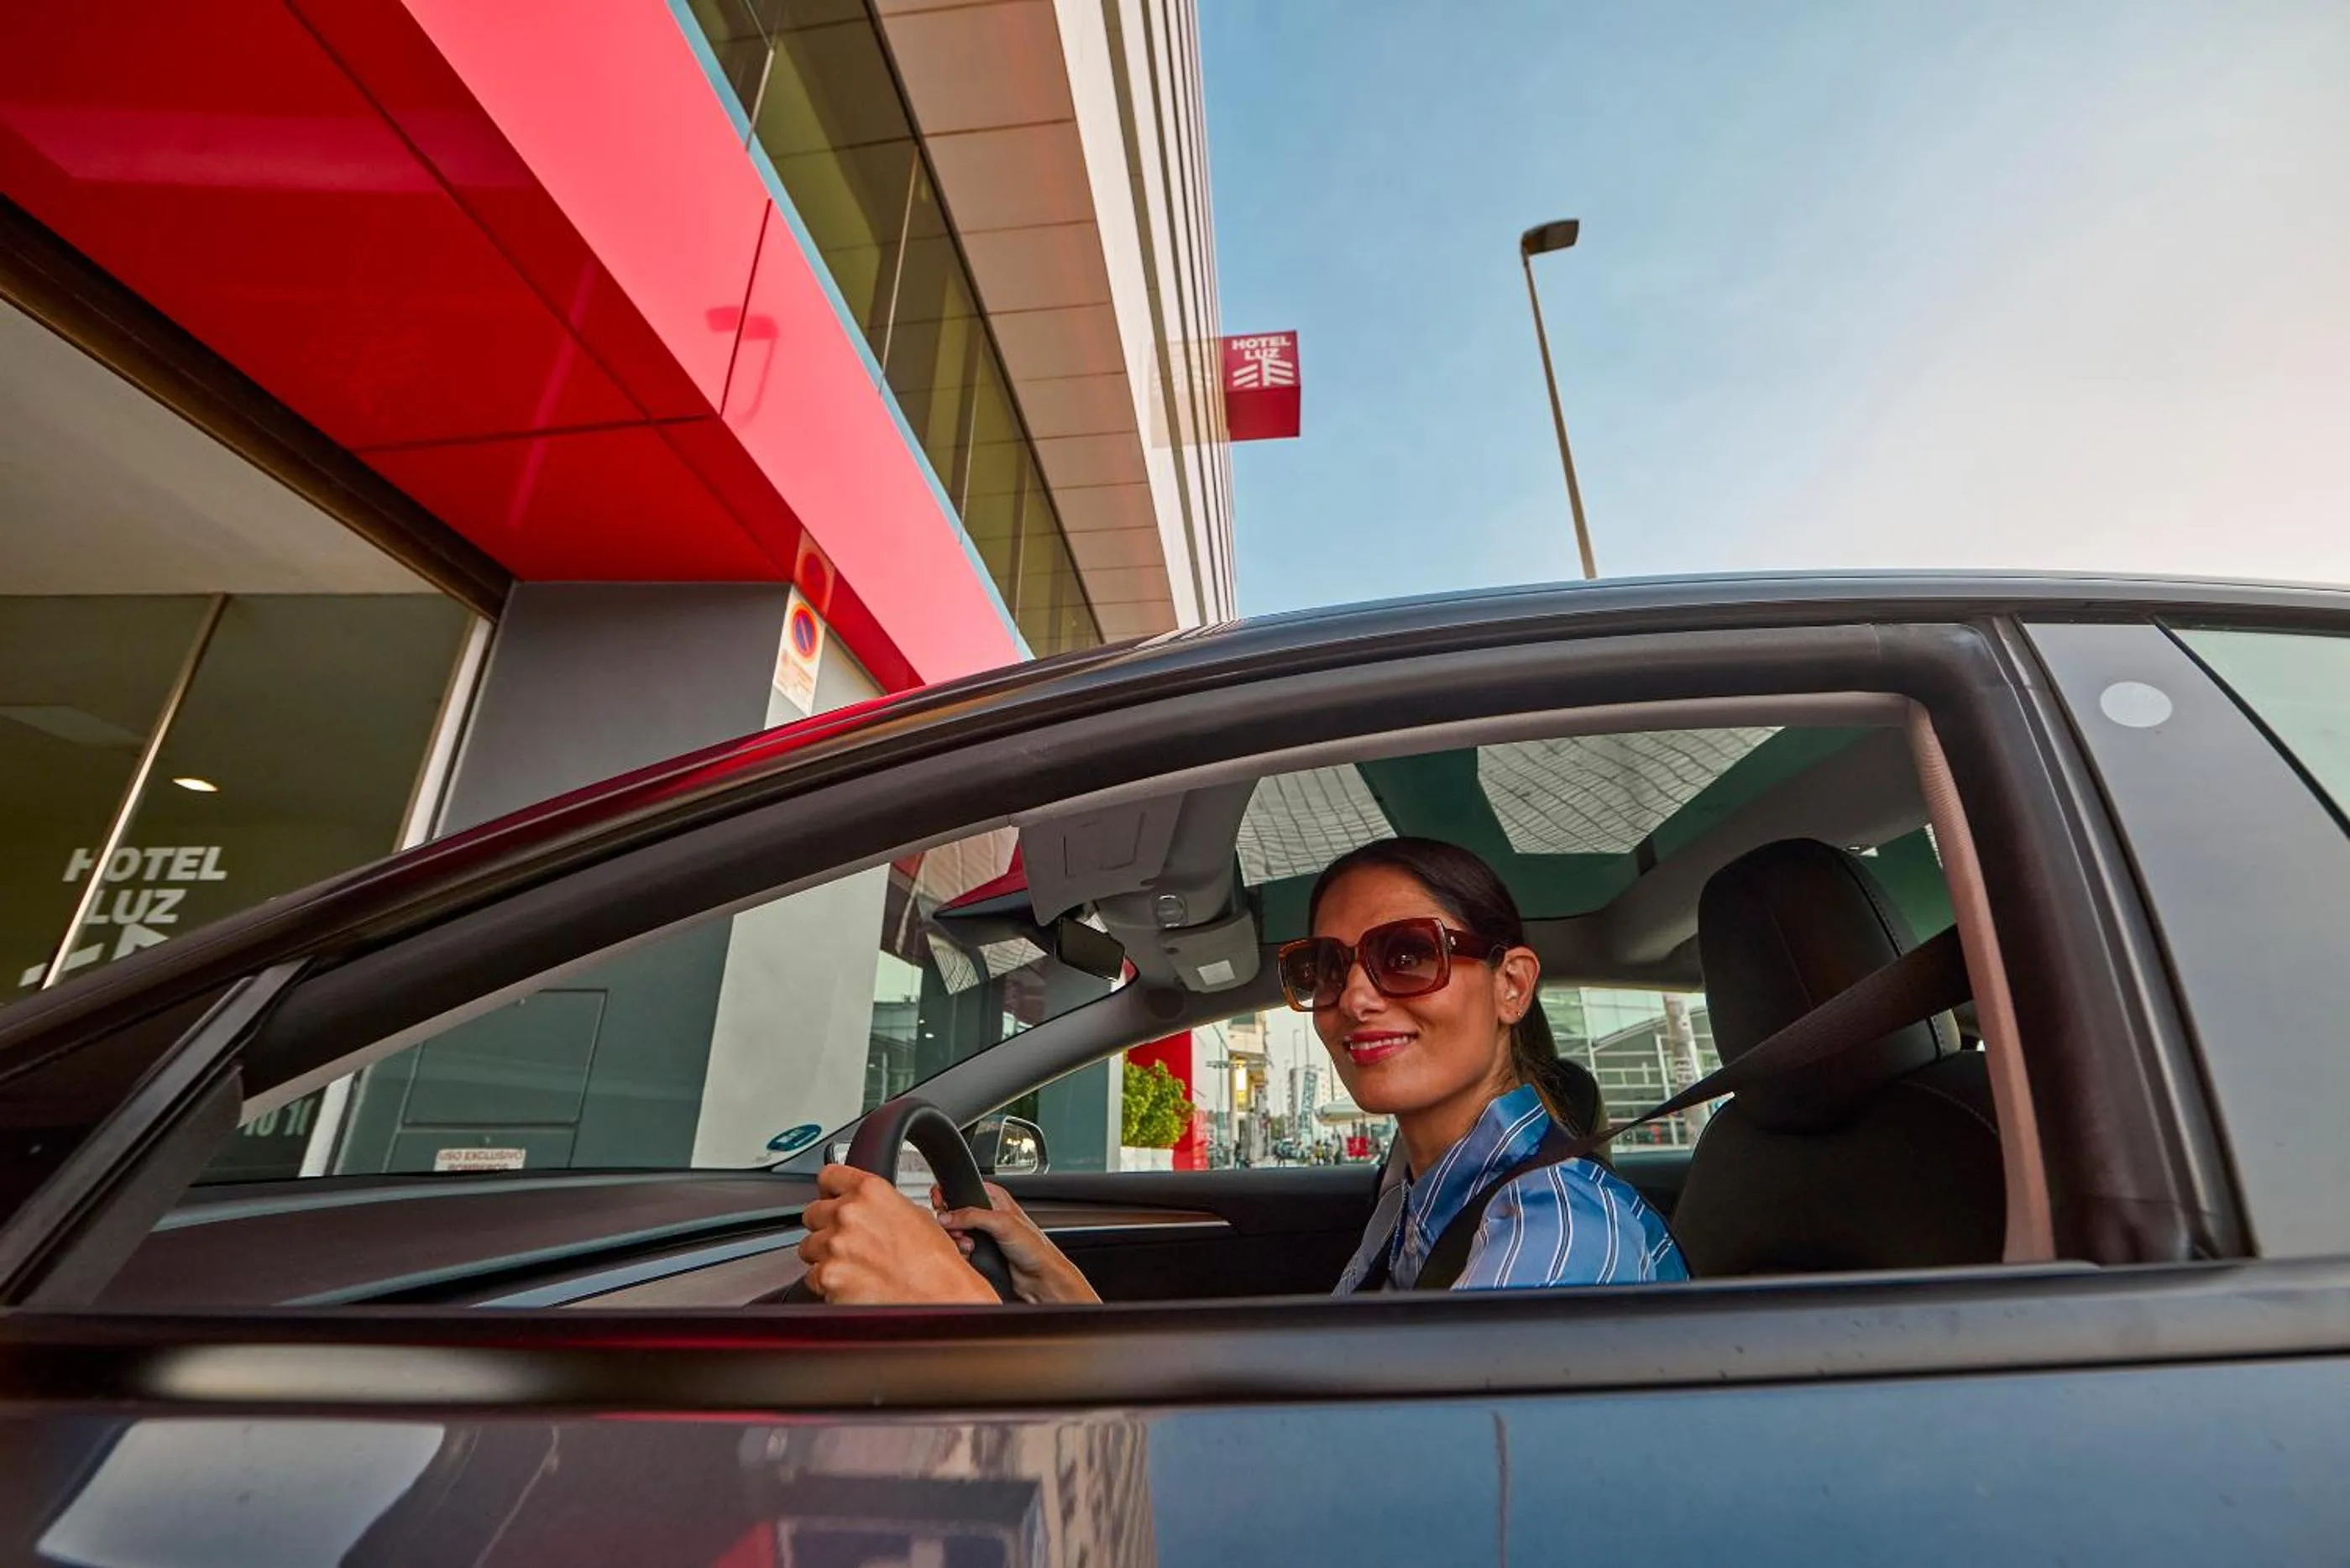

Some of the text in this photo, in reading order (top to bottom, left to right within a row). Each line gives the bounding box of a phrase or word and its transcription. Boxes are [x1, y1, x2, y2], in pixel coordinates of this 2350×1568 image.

[1232, 337, 1291, 350] HOTEL
[1244, 348, 1280, 360] LUZ
[85, 888, 186, 924] LUZ
[464, 1150, 523, 1162] EXCLUSIVO
